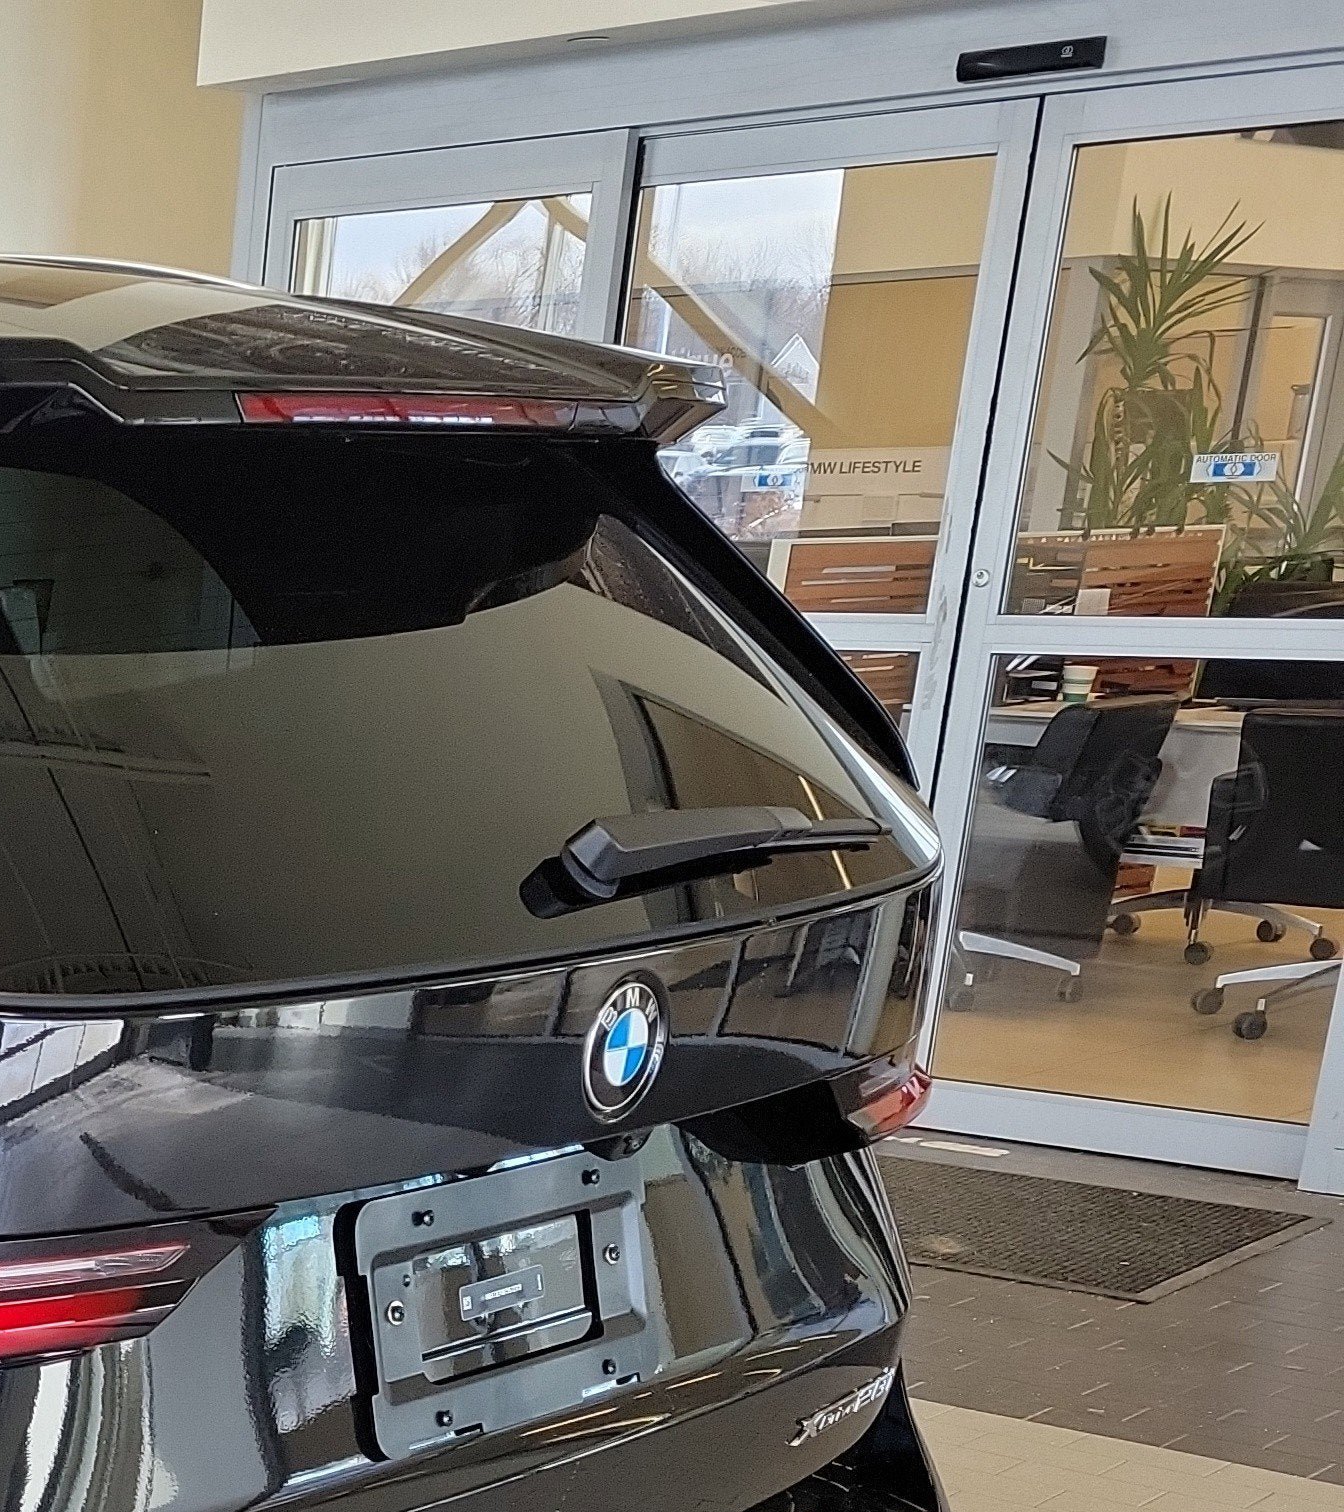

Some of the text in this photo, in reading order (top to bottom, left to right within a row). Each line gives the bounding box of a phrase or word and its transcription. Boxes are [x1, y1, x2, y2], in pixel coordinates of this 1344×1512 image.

[1196, 454, 1276, 463] AUTOMATIC DOOR
[839, 460, 922, 474] LIFESTYLE
[601, 987, 659, 1031] BMW
